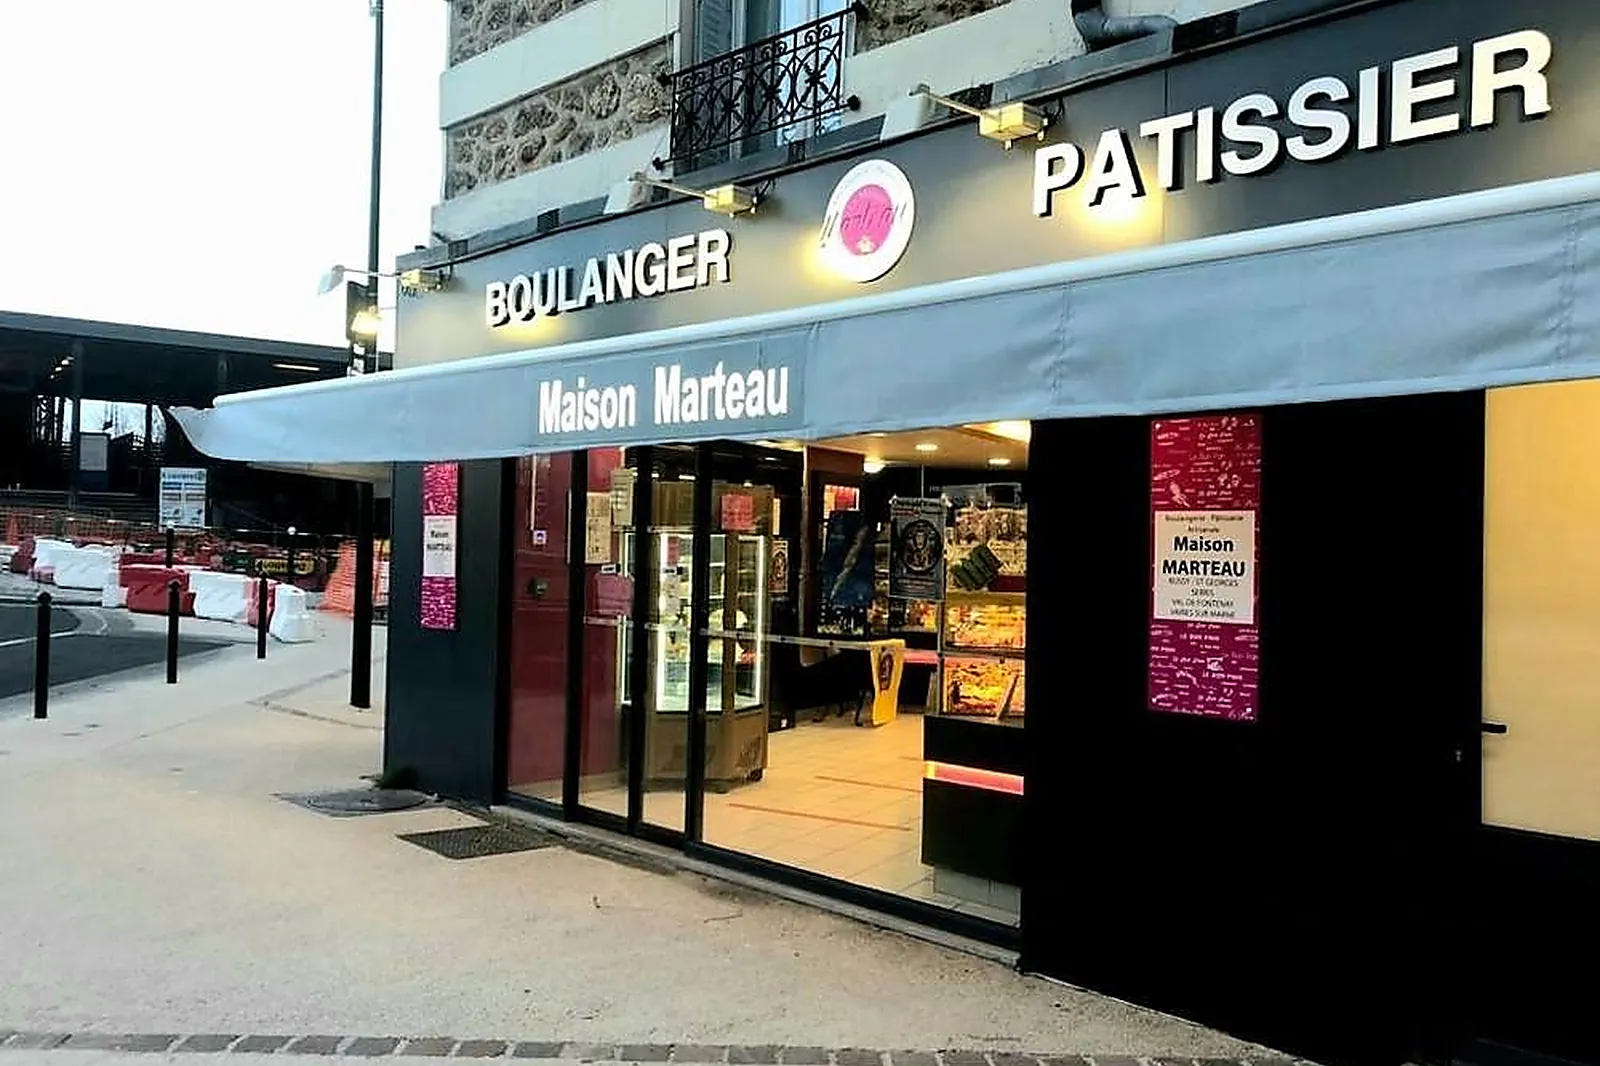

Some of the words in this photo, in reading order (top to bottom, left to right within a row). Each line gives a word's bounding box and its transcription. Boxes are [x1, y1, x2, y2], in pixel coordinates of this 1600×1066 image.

[1032, 28, 1552, 217] PATISSIER
[485, 227, 731, 327] BOULANGER
[538, 377, 636, 434] Maison
[654, 360, 789, 425] Marteau
[1162, 559, 1245, 577] MARTEAU
[1174, 535, 1234, 552] Maison
